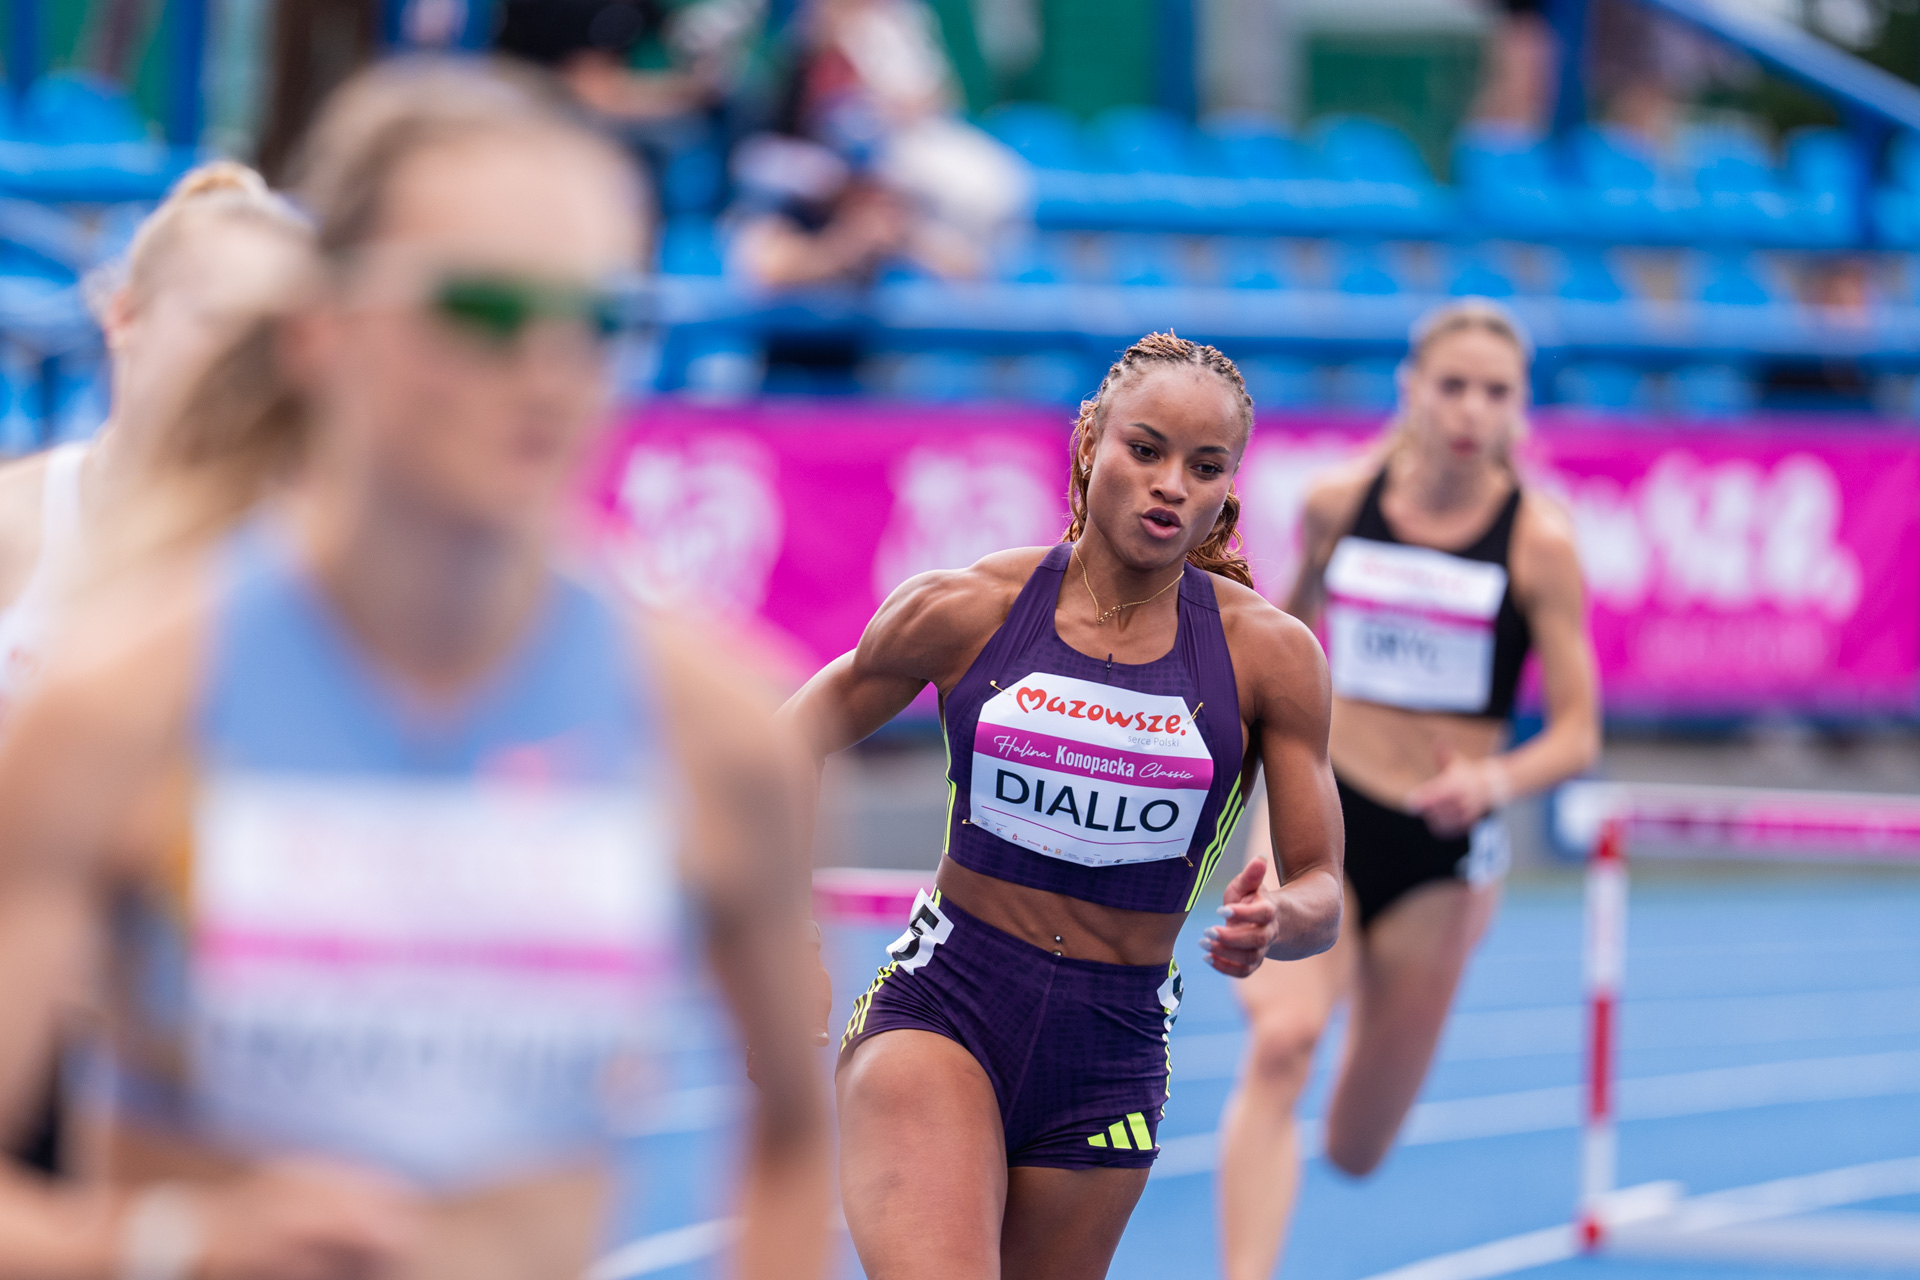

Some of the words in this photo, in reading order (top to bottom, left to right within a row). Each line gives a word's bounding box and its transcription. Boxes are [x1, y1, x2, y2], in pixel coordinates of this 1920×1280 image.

[994, 735, 1051, 758] Halina
[1055, 745, 1135, 778] Konopacka
[1139, 762, 1194, 780] Classic
[1127, 735, 1151, 746] serce
[1153, 737, 1180, 748] Polski
[995, 768, 1180, 832] DIALLO
